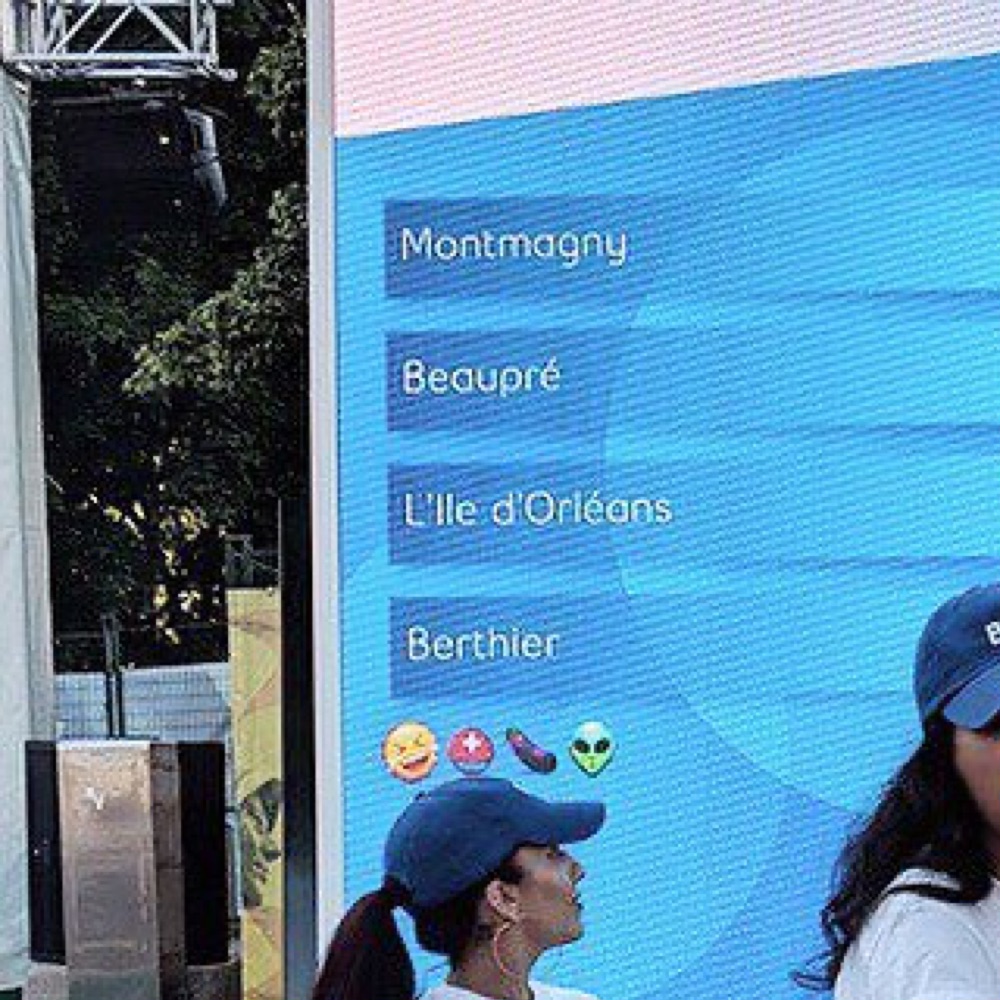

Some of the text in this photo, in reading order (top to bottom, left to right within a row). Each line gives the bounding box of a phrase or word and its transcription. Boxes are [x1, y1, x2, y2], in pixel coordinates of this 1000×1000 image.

[402, 227, 627, 268] Montmagny
[403, 356, 562, 397] Beaupré
[493, 489, 674, 526] d'Orléans
[408, 624, 561, 661] Berthier
